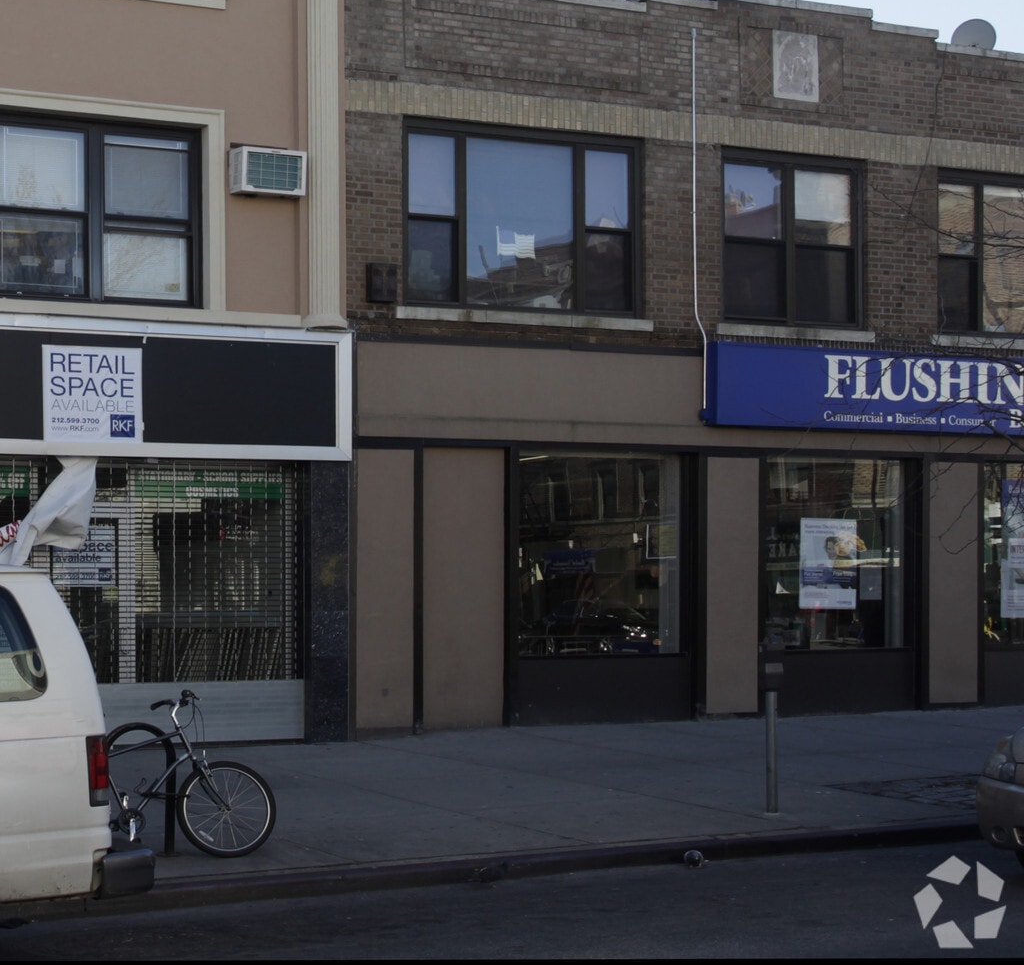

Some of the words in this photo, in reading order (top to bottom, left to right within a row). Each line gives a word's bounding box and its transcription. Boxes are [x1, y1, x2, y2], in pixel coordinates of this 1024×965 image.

[50, 352, 135, 375] RETAIL
[50, 375, 134, 398] SPACE
[51, 398, 135, 413] AVAILABLE
[51, 417, 100, 425] 212.599.3700
[111, 419, 134, 432] RKF
[823, 411, 884, 424] Commercial
[895, 413, 937, 426] Business
[948, 415, 997, 427] Consumr
[7, 472, 26, 489] OFF
[203, 471, 239, 482] SCHOOL
[185, 486, 239, 498] COSMETICS
